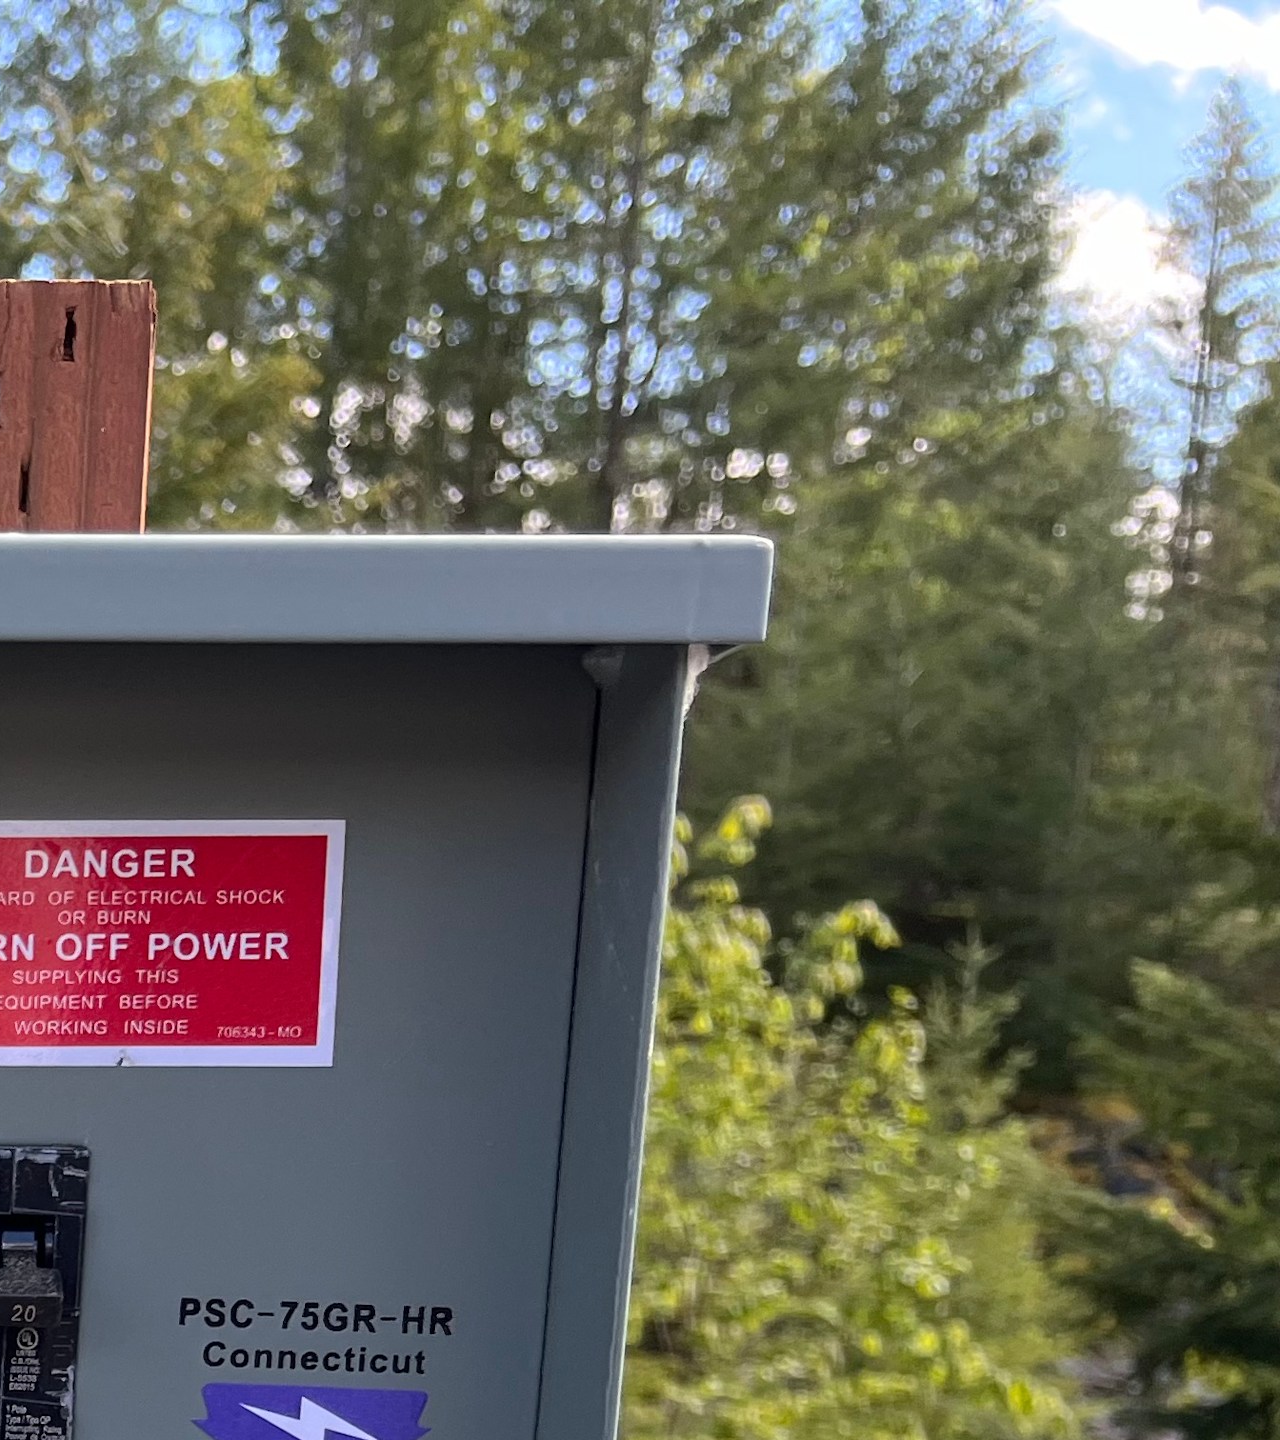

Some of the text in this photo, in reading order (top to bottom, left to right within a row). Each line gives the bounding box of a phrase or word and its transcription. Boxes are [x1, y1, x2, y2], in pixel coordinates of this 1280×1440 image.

[24, 848, 195, 879] DANGER
[48, 890, 75, 906] OF
[87, 889, 207, 906] ELECTRICAL
[215, 889, 285, 905] SHOCK
[57, 909, 151, 926] OR BURN
[55, 932, 130, 961] OFF
[148, 932, 289, 961] POWER
[12, 968, 179, 985] SUPPLYING THIS
[14, 1019, 189, 1035] WORKING INSIDE
[10, 1303, 36, 1323] 20
[178, 1297, 453, 1336] PSC-75GR-HR
[202, 1341, 426, 1375] Connecticut
